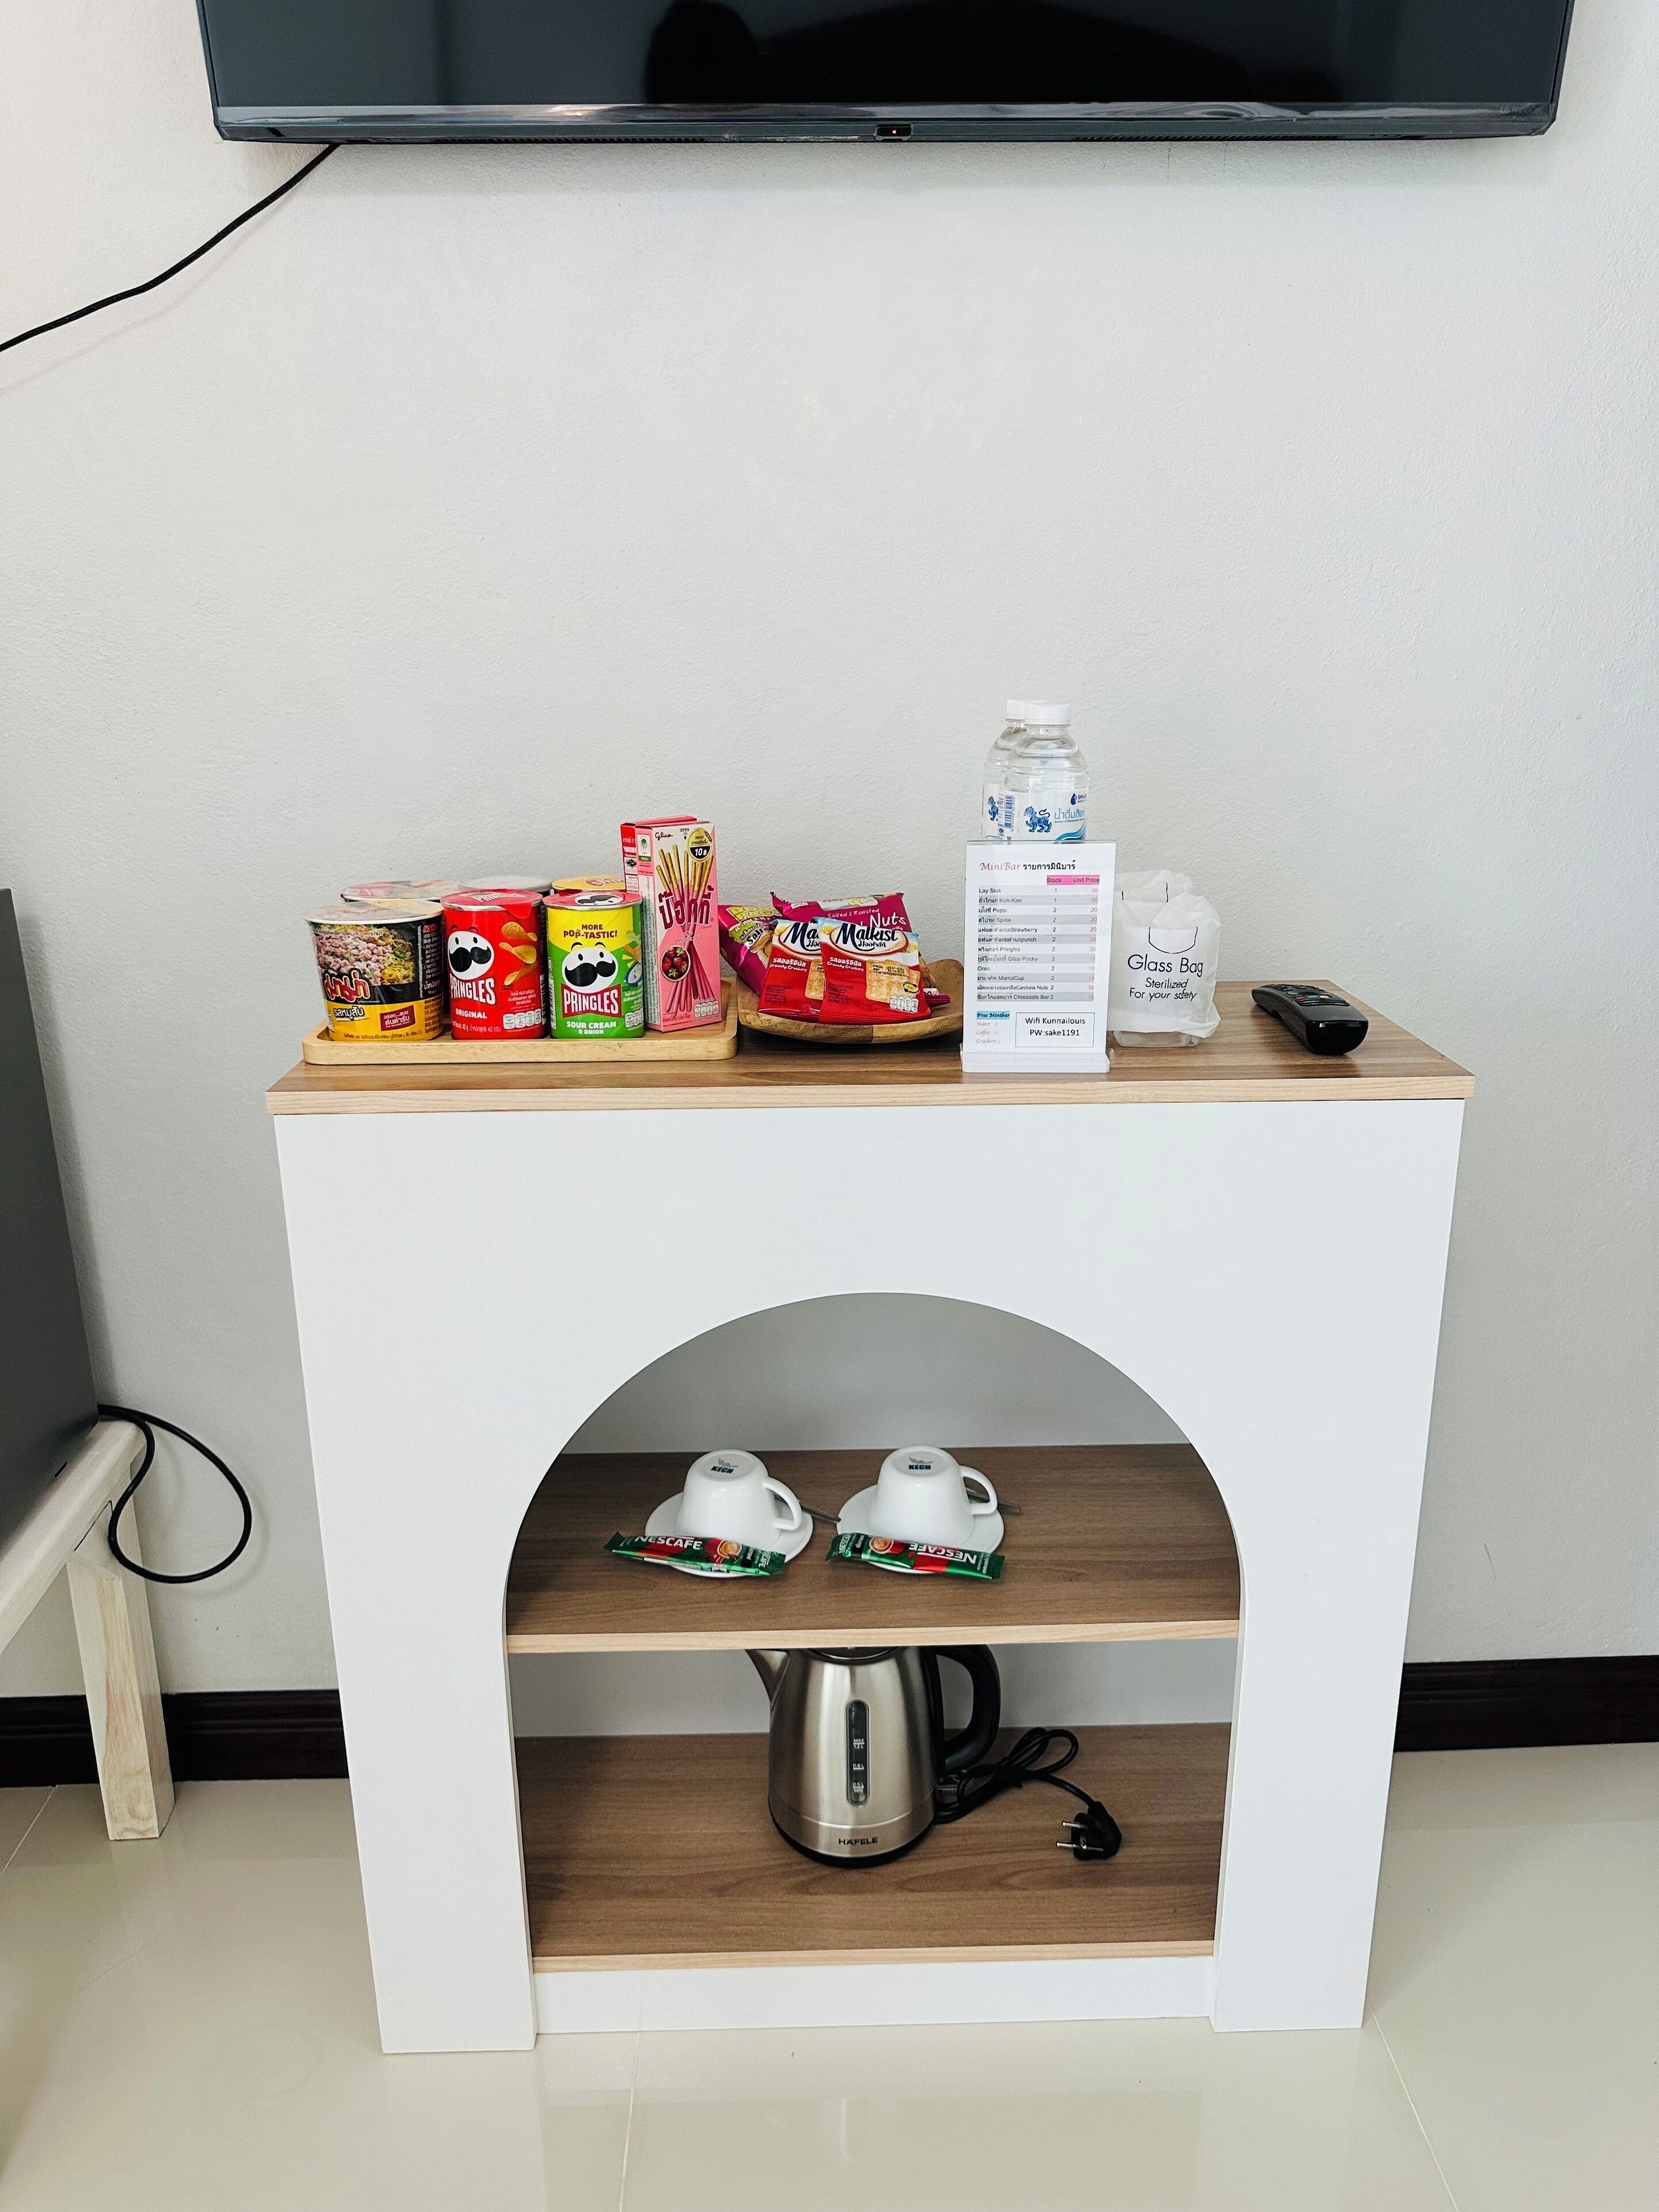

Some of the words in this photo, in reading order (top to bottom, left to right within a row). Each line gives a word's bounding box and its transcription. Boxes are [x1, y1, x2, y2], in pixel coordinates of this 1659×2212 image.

[1022, 859, 1077, 870] รายการมินิบาร์
[854, 908, 880, 916] Roasted
[869, 912, 907, 928] Nuts
[563, 929, 618, 939] POP-TASTIC!
[1127, 953, 1173, 972] Glass
[1180, 957, 1204, 978] Bag
[1145, 978, 1190, 988] Sterilized
[449, 973, 496, 1005] PRINGLES
[1130, 987, 1146, 999] For
[1149, 991, 1171, 1002] your
[1175, 988, 1198, 1001] safety
[563, 988, 619, 1014] PRINGLES
[455, 1008, 487, 1019] ORIGINAL
[566, 1021, 587, 1029] SOUR
[588, 1021, 617, 1029] CREAM
[976, 1029, 991, 1037] Coffee
[711, 1465, 734, 1475] KECH
